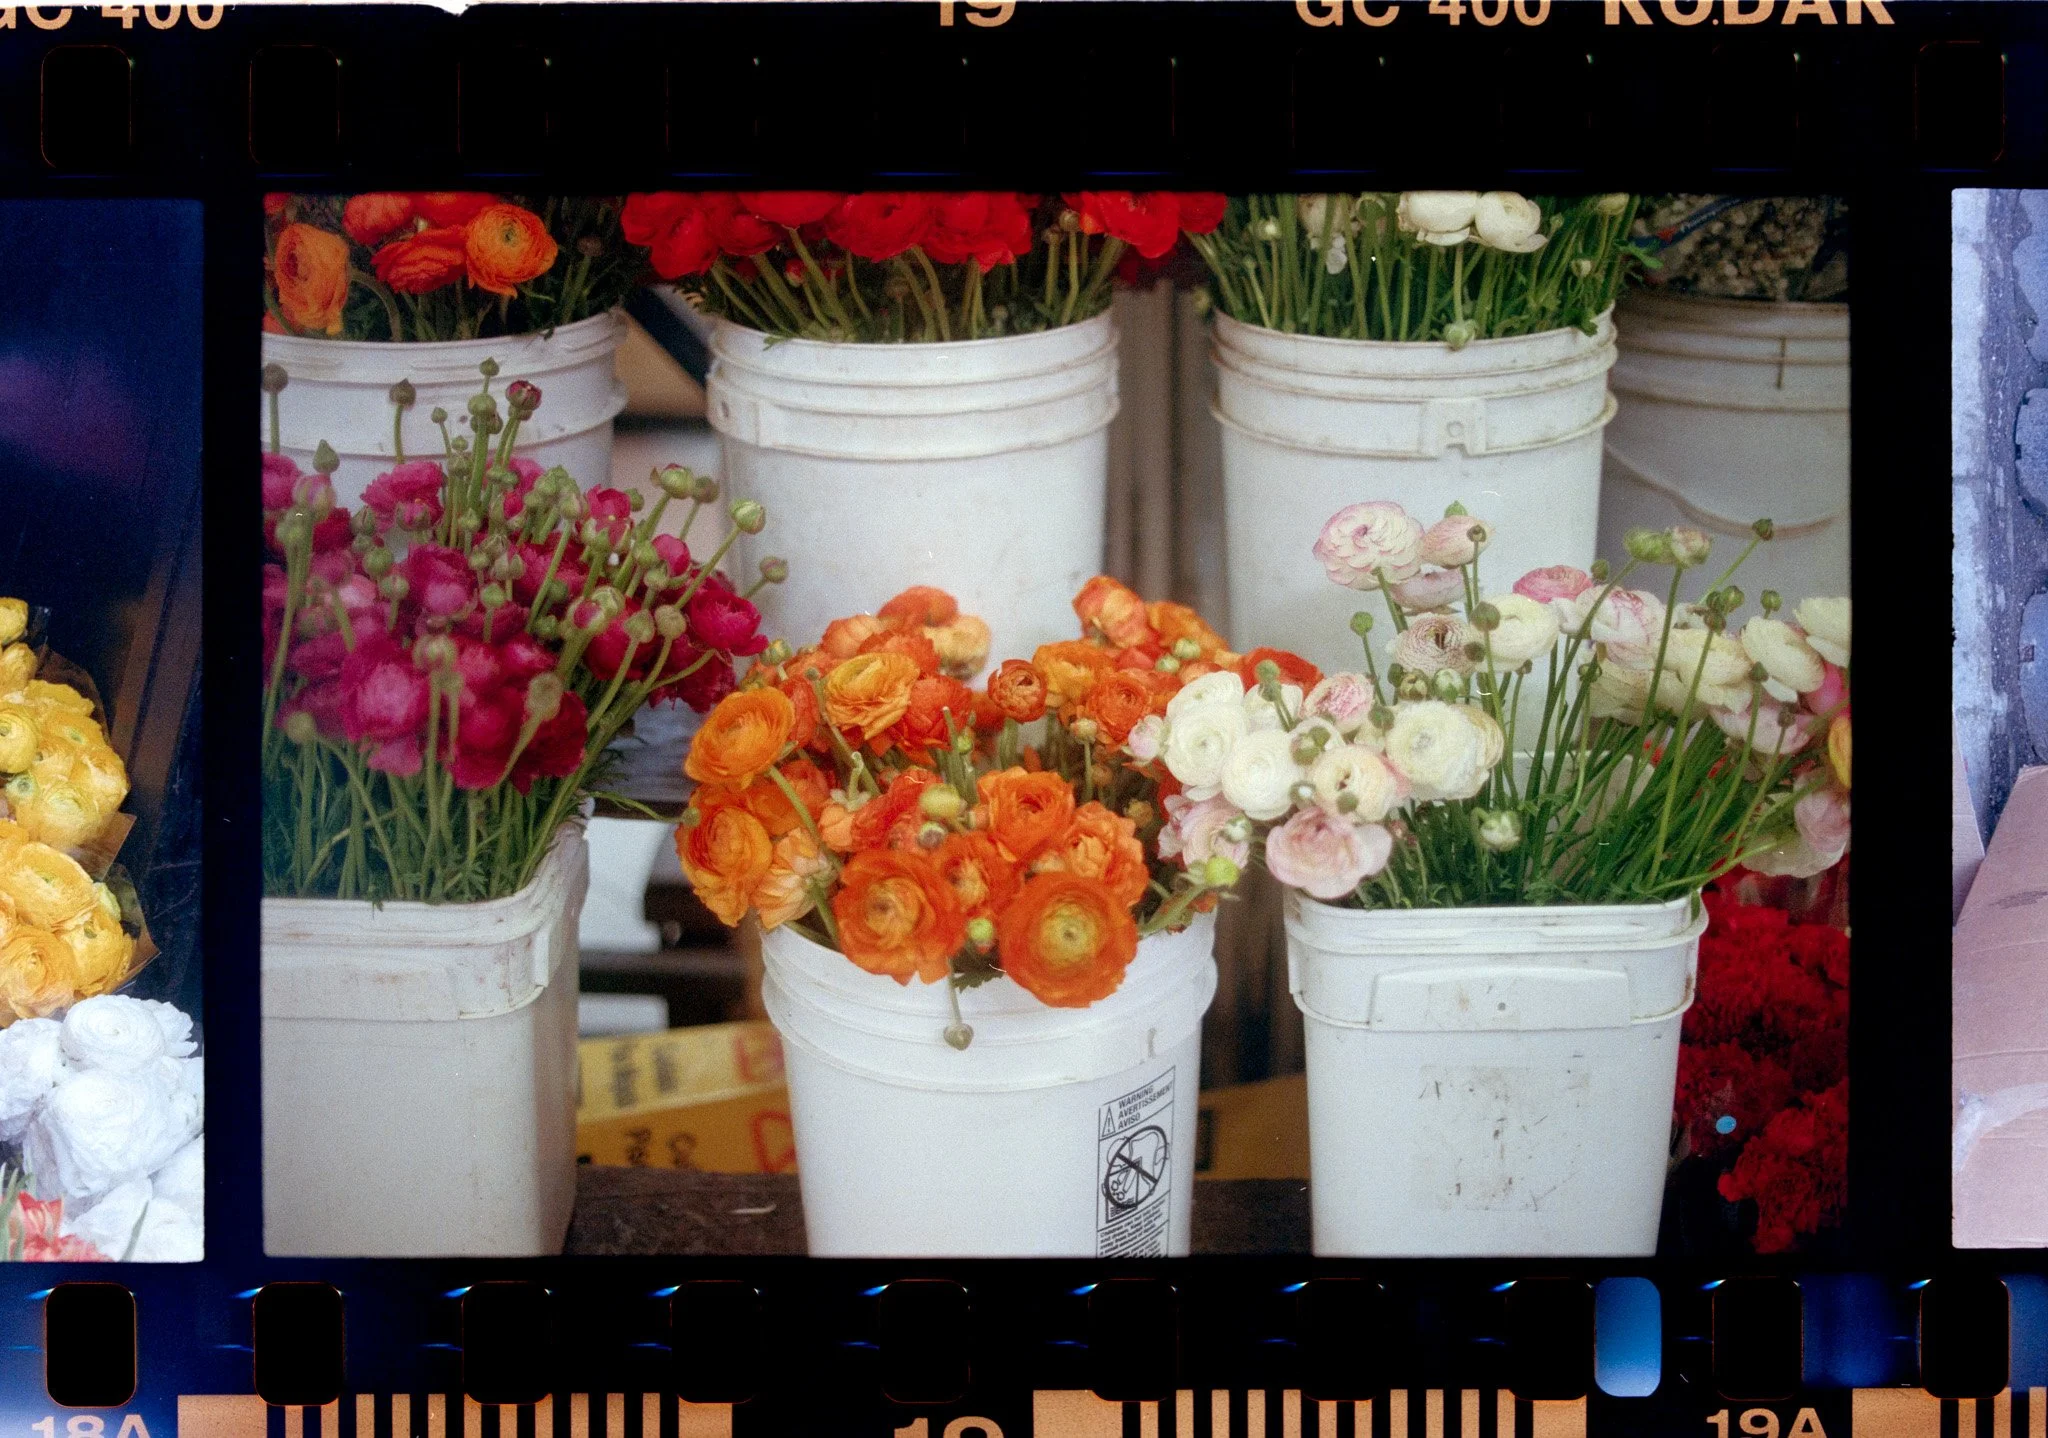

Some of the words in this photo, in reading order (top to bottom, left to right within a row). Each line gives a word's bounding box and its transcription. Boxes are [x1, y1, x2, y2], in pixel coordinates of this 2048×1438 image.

[101, 5, 224, 30] 400
[1294, 1, 1400, 27] GC
[1428, 1, 1551, 27] 400
[1118, 1085, 1154, 1109] WARNING
[1118, 1080, 1173, 1120] AVERTISSEMENT
[1118, 1112, 1141, 1130] AVISO
[31, 1414, 151, 1438] 18A
[1706, 1407, 1828, 1438] 19A
